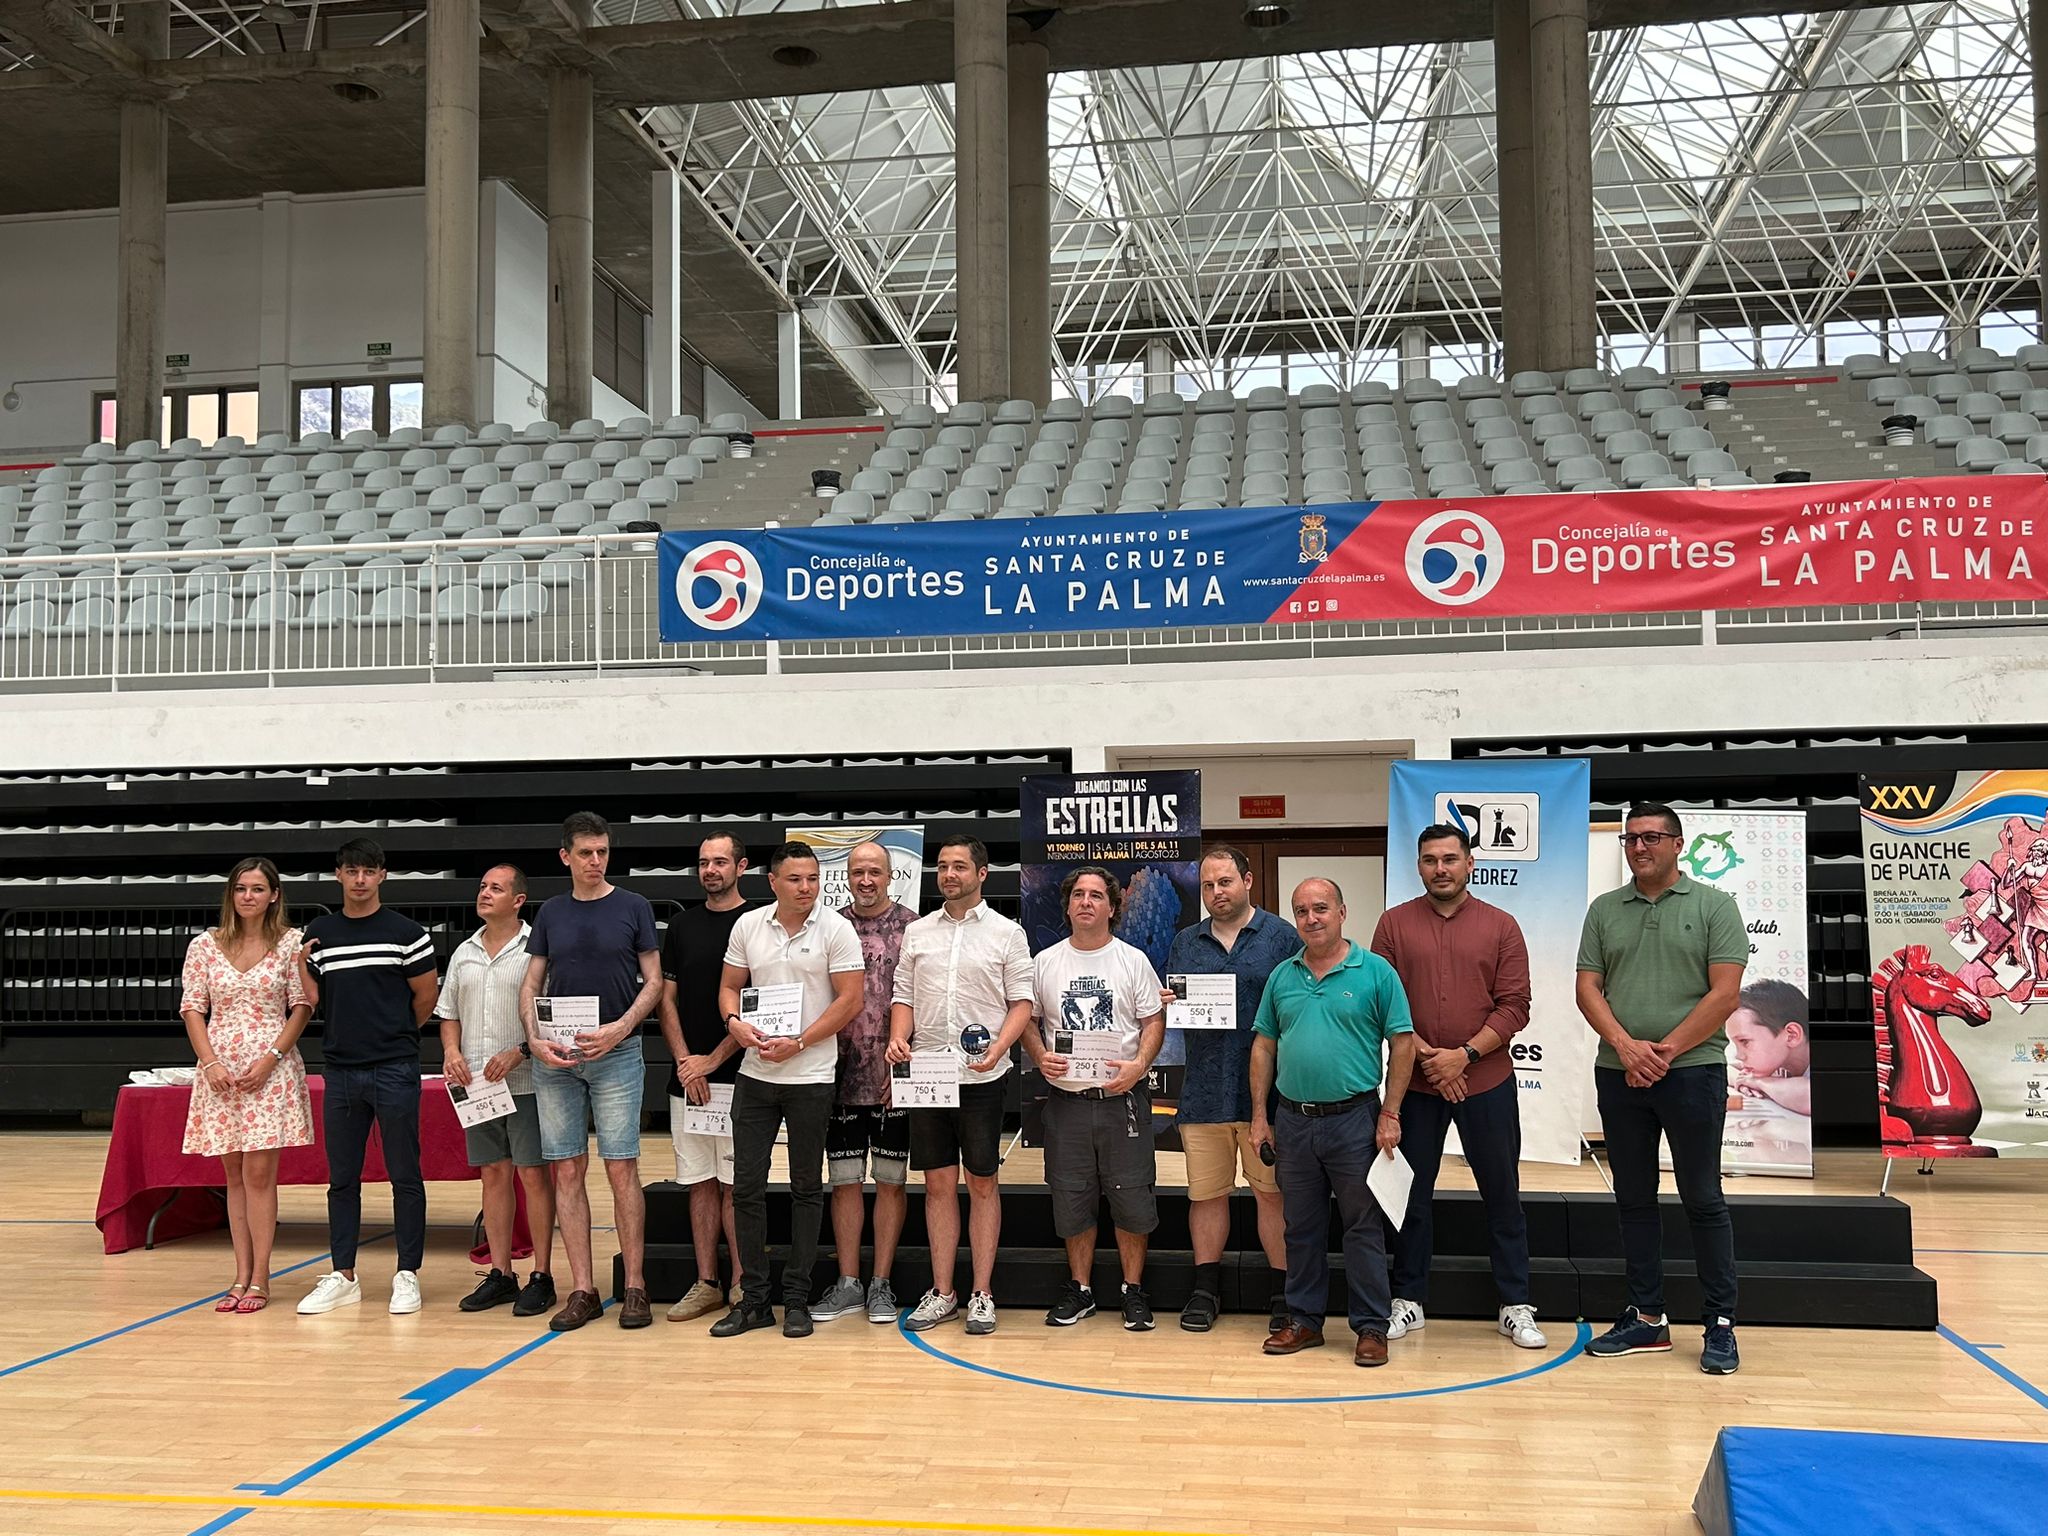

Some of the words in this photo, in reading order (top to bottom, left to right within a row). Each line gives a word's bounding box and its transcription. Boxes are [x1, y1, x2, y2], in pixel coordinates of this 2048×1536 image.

[1801, 496, 1956, 516] AYUNTAMIENTO
[1968, 496, 1992, 509] DE
[1021, 530, 1159, 548] AYUNTAMIENTO
[1168, 528, 1190, 541] DE
[1559, 521, 1650, 542] Concejalía
[1654, 527, 1669, 537] de
[1760, 520, 1874, 546] SANTA
[1897, 517, 1988, 538] CRUZ
[2000, 520, 2033, 536] DE
[810, 552, 890, 570] Concejalía
[894, 557, 906, 567] de
[985, 554, 1085, 576] SANTA
[1106, 549, 1186, 570] CRUZ
[1197, 550, 1226, 567] DE
[1532, 536, 1736, 584] Deportes
[1760, 552, 1819, 587] LA
[1854, 546, 2033, 583] PALMA
[786, 566, 965, 611] Deportes
[1243, 572, 1386, 588] www.santacruzdelapalma.es
[984, 583, 1037, 616] LA
[1068, 575, 1226, 613] PALMA
[1074, 780, 1110, 795] JUGANDO
[1112, 779, 1130, 793] CON
[1131, 778, 1147, 793] LAS
[1253, 799, 1272, 807] SIN
[1868, 785, 1936, 810] XXV
[1045, 794, 1179, 836] ESTRELLAS
[1046, 844, 1055, 852] VI
[1056, 843, 1086, 852] TORNEO
[1092, 842, 1111, 851] ISLA
[1116, 842, 1129, 851] DE
[1135, 841, 1149, 850] DEL
[1150, 841, 1156, 850] 5
[1157, 841, 1167, 850] AL
[1169, 840, 1179, 849] 11
[1869, 841, 1971, 860] GUANCHE
[1092, 851, 1103, 860] LA
[1103, 850, 1130, 860] PALMA
[1871, 863, 1893, 881] DE
[1899, 862, 1951, 881] PLATA
[1069, 979, 1106, 991] ESTRELLAS
[1190, 1007, 1206, 1016] 550
[1207, 1007, 1213, 1016] €
[1511, 1043, 1543, 1062] es
[1075, 1061, 1091, 1070] 250
[1092, 1061, 1099, 1070] €
[914, 1086, 930, 1095] 750
[931, 1086, 936, 1095] €
[475, 1101, 489, 1111] 450
[488, 1099, 495, 1107] €
[706, 1115, 720, 1123] 175
[721, 1115, 726, 1124] €
